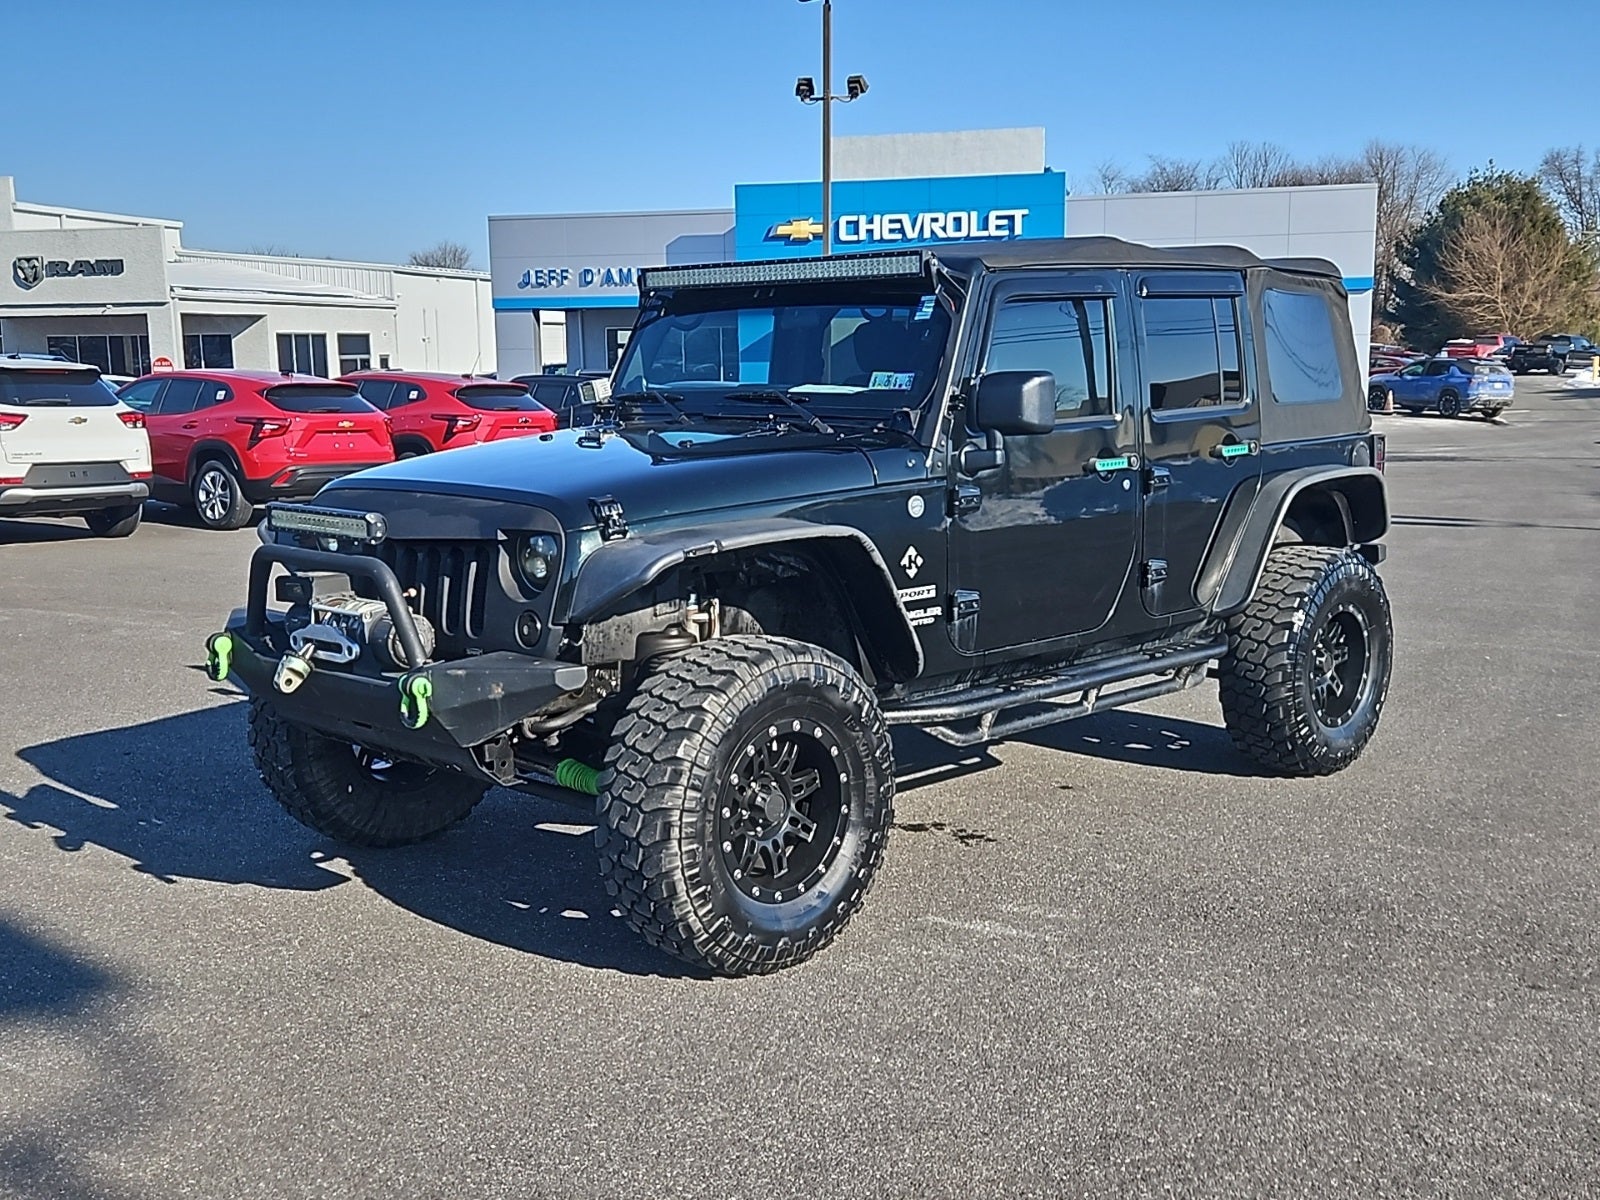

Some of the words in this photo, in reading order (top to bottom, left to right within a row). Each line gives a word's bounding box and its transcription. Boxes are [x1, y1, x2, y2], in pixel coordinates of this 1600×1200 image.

[838, 209, 1030, 241] CHEVROLET
[46, 259, 124, 277] RAM
[520, 268, 570, 288] JEFF
[581, 267, 640, 287] D'AM
[898, 588, 934, 599] PORT
